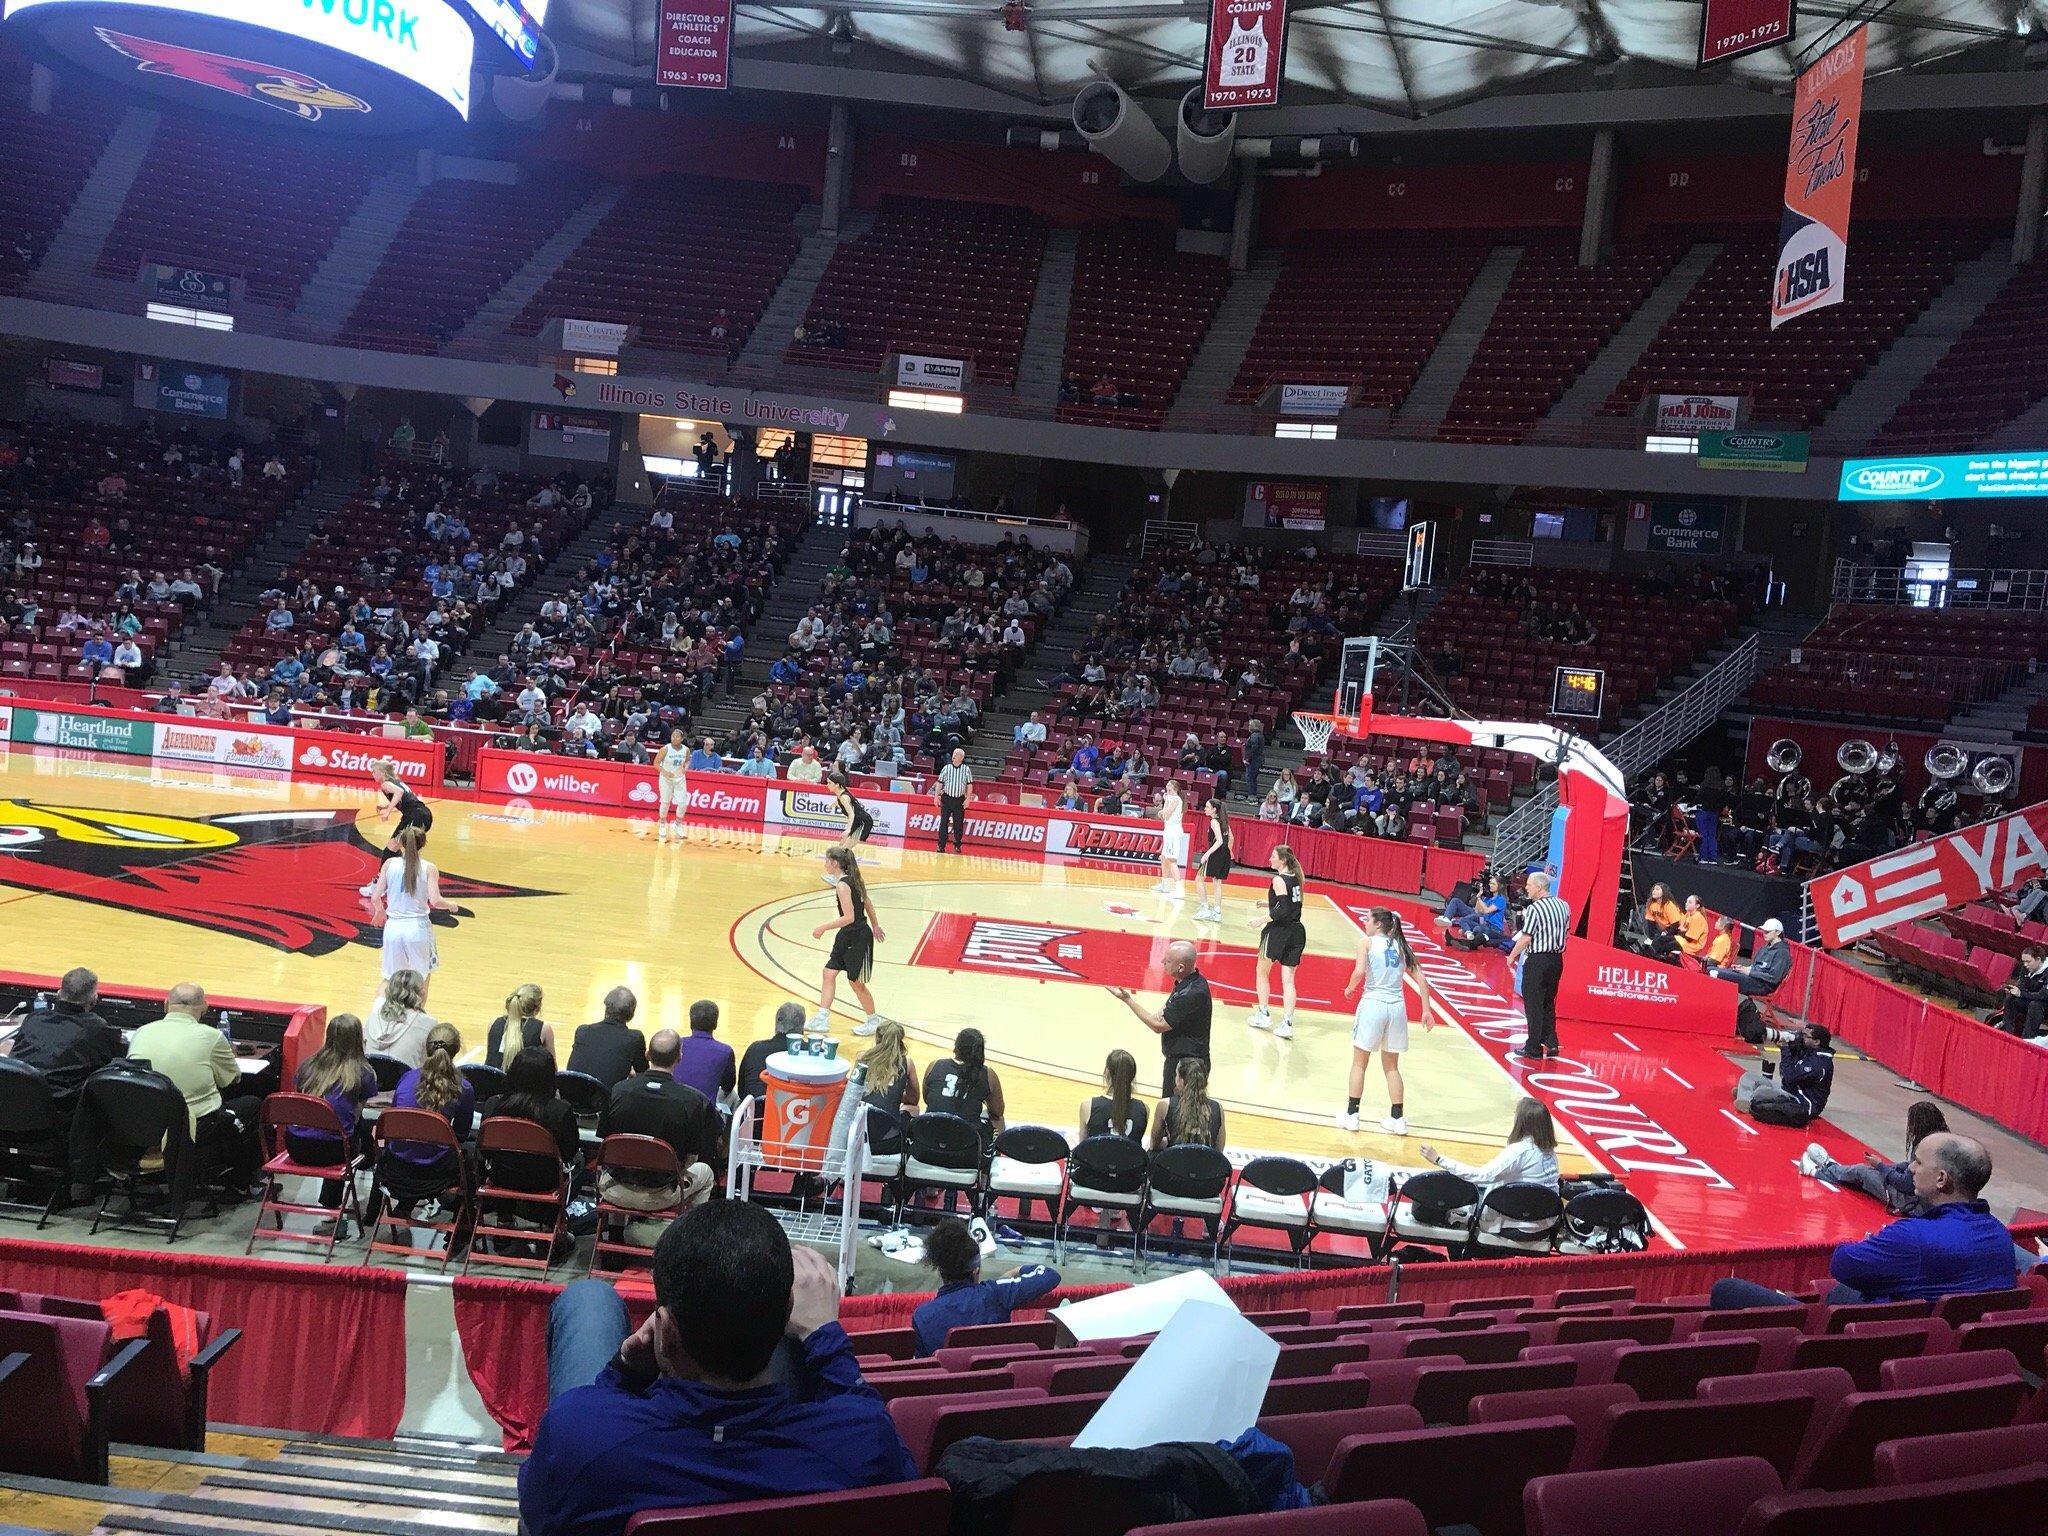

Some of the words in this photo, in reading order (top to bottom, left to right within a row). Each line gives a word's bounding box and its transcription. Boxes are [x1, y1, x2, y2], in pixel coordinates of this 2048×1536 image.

[1227, 2, 1272, 14] COLLINS
[666, 12, 711, 23] DIRECTOR
[712, 15, 726, 24] OF
[671, 22, 719, 33] ATHLETICS
[1716, 20, 1781, 50] 1970-1975
[677, 34, 712, 45] COACH
[1229, 34, 1263, 50] ILLINOIS
[669, 47, 718, 58] EDUCATOR
[1233, 46, 1256, 64] 20
[1231, 64, 1255, 76] STATE
[1806, 38, 1857, 95] ILLINOIS
[662, 70, 688, 81] 1963
[697, 72, 722, 83] 1993
[1210, 90, 1237, 102] 1970
[1246, 88, 1272, 99] 1973
[778, 136, 796, 150] AA
[901, 153, 918, 167] BB
[1082, 171, 1099, 184] BB
[1555, 177, 1574, 192] CC
[1668, 172, 1690, 188] DD
[1388, 182, 1406, 196] CC
[161, 386, 223, 404] Commerce
[1296, 388, 1321, 397] Direct
[175, 399, 204, 412] Bank
[599, 383, 665, 408] Illinois
[674, 391, 733, 416] State
[743, 400, 849, 431] University
[1661, 404, 1692, 418] PAPA
[1730, 437, 1777, 446] COUNTRY
[1858, 469, 1931, 484] COUNTRY
[1254, 484, 1265, 500] C
[1634, 502, 1646, 519] D
[1653, 524, 1719, 539] Commerce
[1666, 536, 1698, 549] Bank
[60, 714, 132, 737] Heartland
[60, 730, 98, 748] Bank
[224, 750, 258, 765] Famous
[543, 773, 599, 795] wilber
[796, 798, 833, 814] State
[1385, 947, 1400, 969] 15
[1598, 965, 1668, 990] HELLER
[1588, 986, 1678, 1005] HellerStores.com
[786, 1099, 811, 1125] G
[1504, 1050, 1737, 1191] COURT
[1343, 1158, 1357, 1172] G
